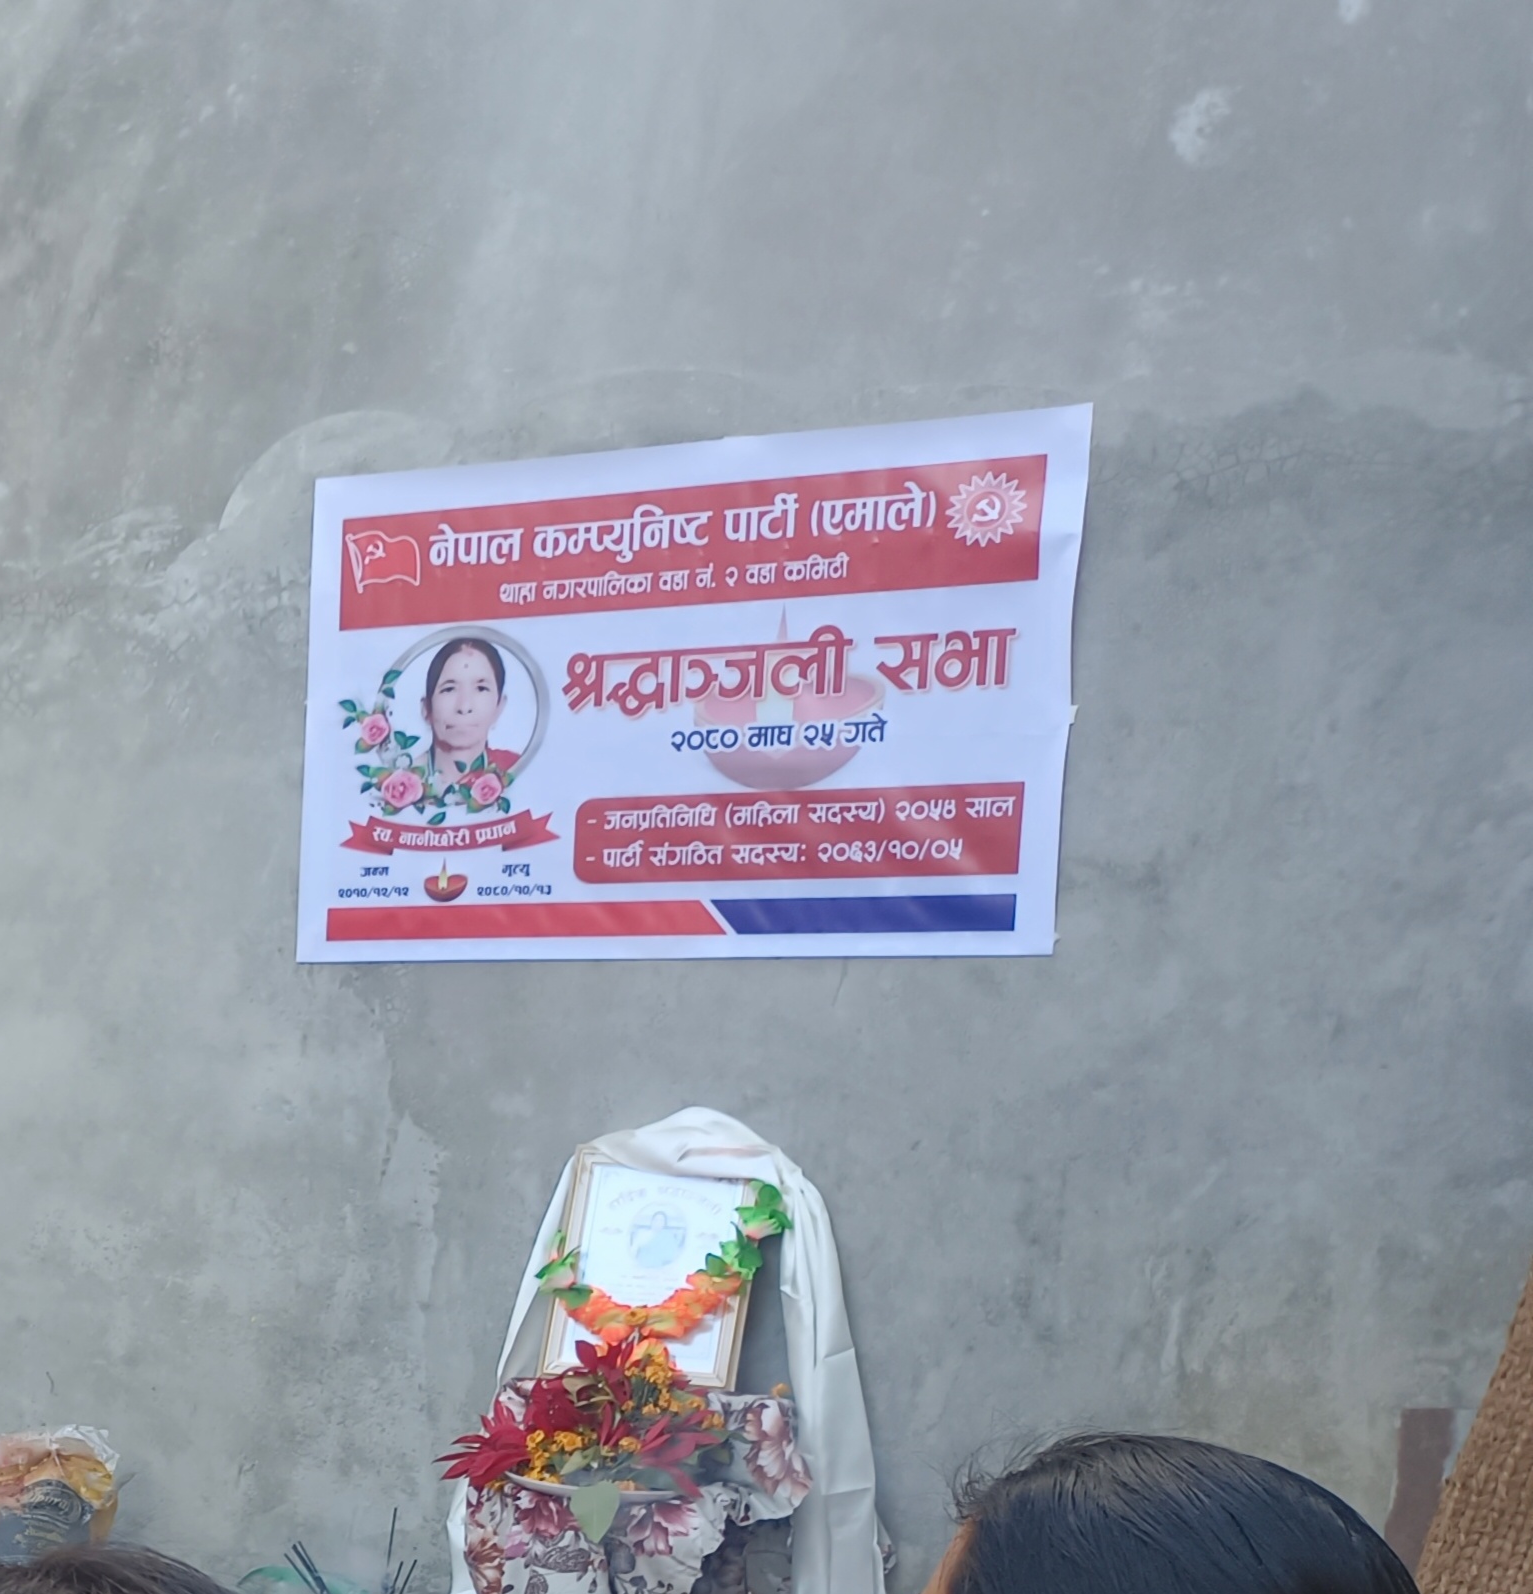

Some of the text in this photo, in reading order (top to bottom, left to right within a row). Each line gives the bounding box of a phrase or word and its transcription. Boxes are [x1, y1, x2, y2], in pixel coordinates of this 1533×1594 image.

[429, 481, 937, 566] नेपाल कम्प्युनिष्ट पार्टी (एमाले)
[499, 581, 536, 605] थाहा
[542, 571, 653, 600] नगरपालिका
[659, 569, 690, 592] वडा
[725, 566, 738, 587] २
[745, 562, 777, 584] वडा
[562, 624, 1017, 717] श्रद्धाञ्जली सभा
[670, 713, 888, 752] २०८० माघ २५ गते
[475, 820, 517, 844] प्रधान
[604, 802, 718, 832] जनप्रतिनिधि
[725, 800, 801, 828] (महिला
[807, 797, 885, 825] सदस्य)
[895, 799, 956, 821] २०५४
[965, 796, 1016, 818] साल
[603, 840, 644, 867] पार्टी
[649, 841, 724, 866] संगठित
